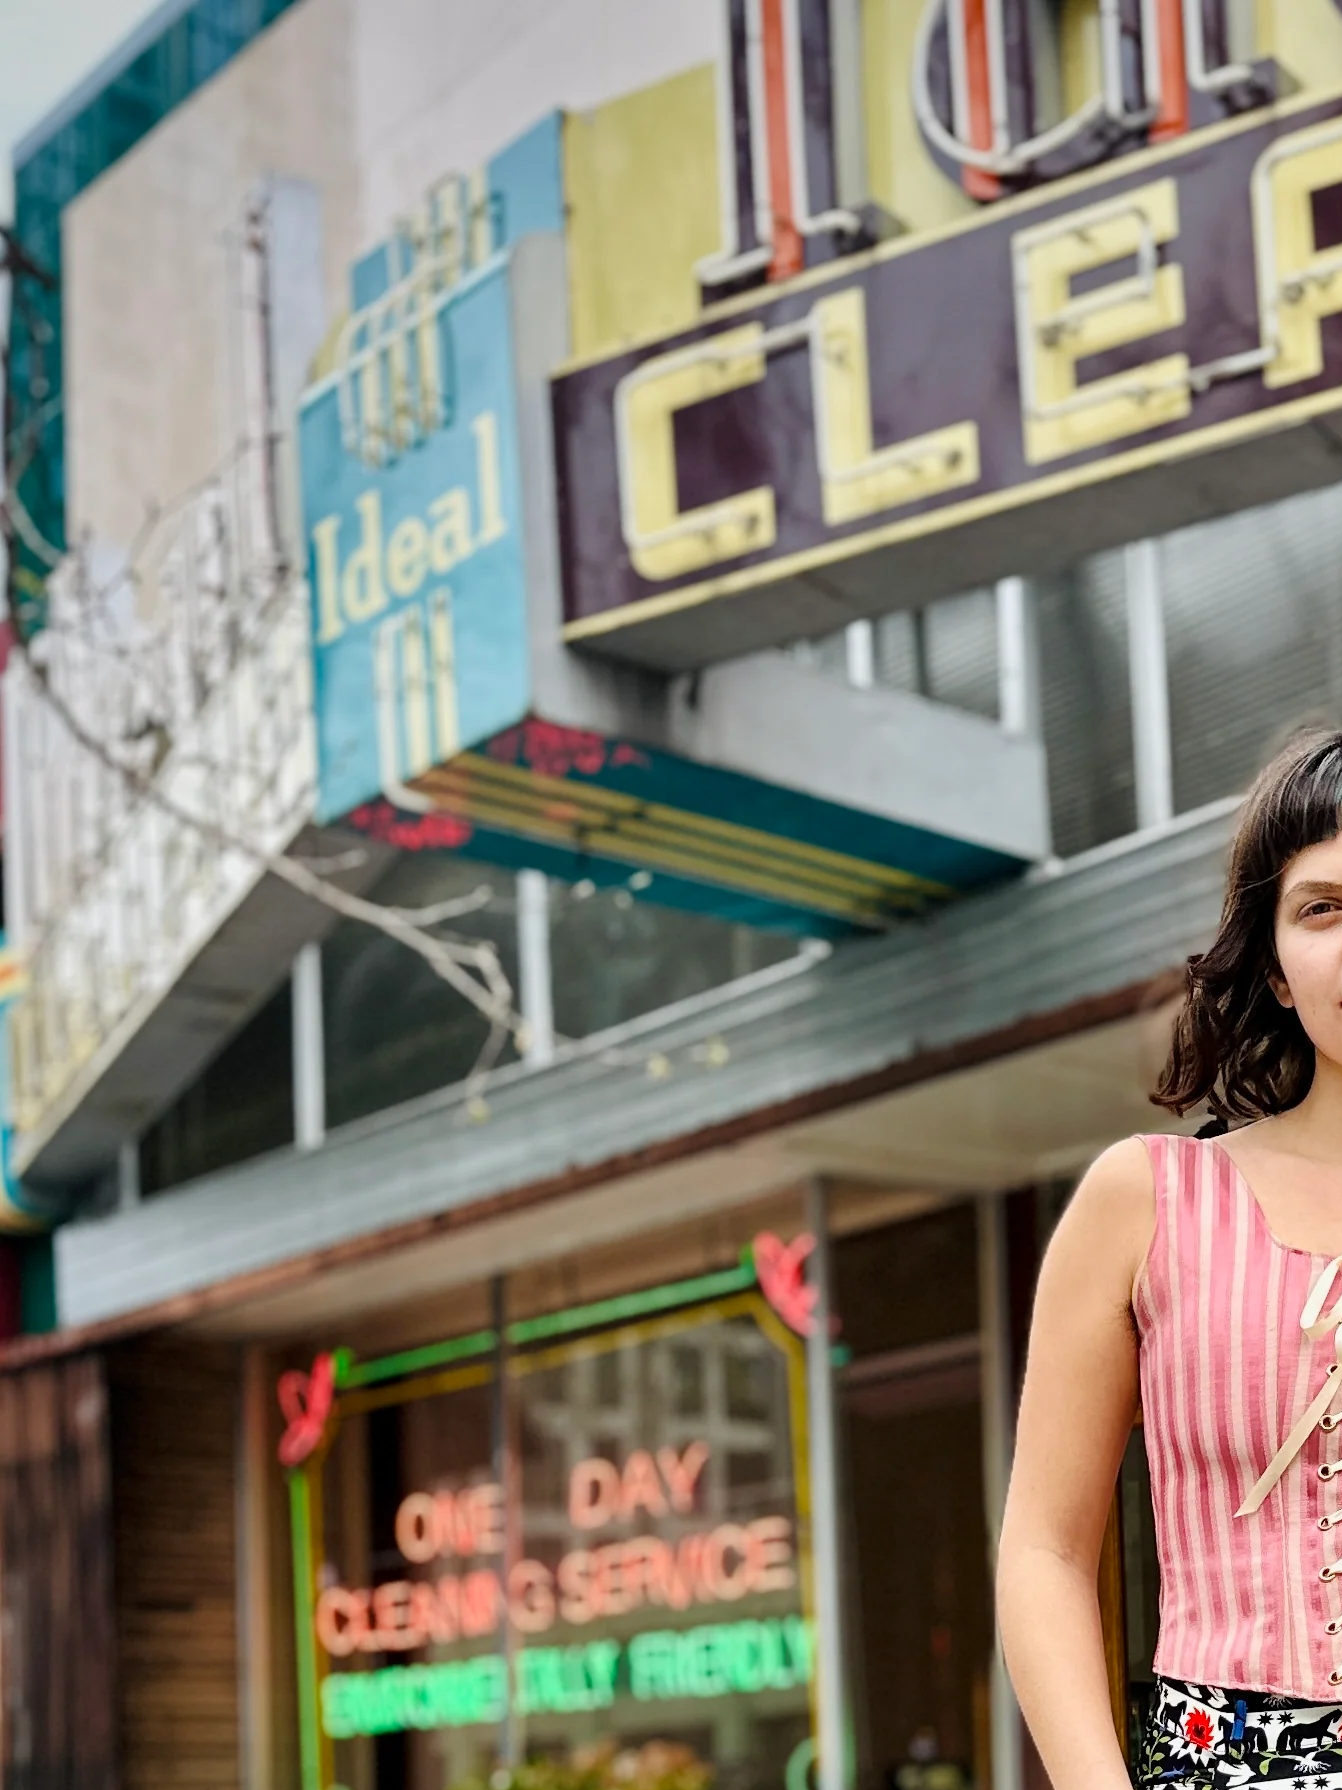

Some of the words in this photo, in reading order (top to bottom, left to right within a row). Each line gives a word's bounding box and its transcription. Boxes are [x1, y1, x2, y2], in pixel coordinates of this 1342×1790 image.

[313, 412, 507, 645] Ideal
[395, 1483, 506, 1563] ONE
[569, 1441, 709, 1530] DAY
[558, 1516, 797, 1624] SERVICE
